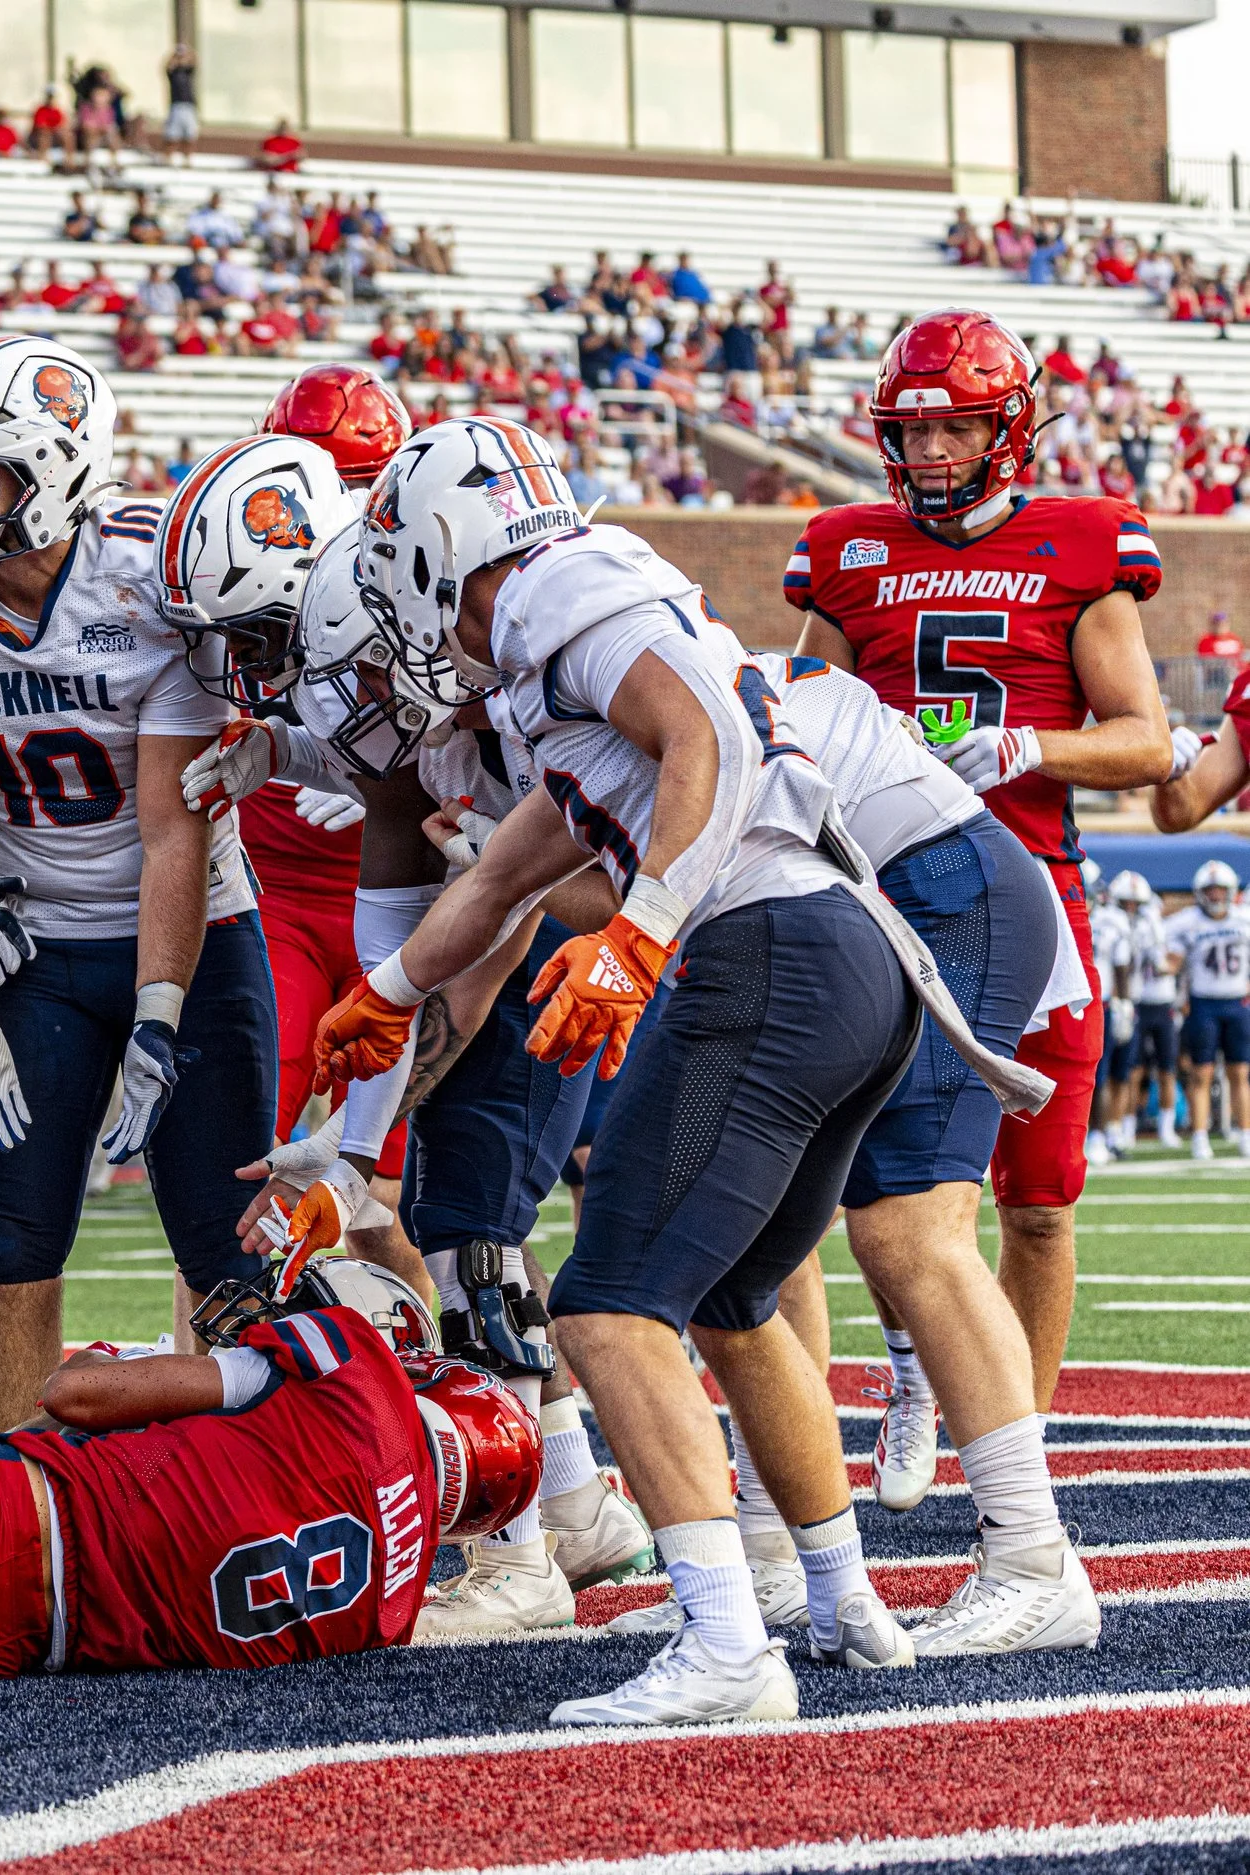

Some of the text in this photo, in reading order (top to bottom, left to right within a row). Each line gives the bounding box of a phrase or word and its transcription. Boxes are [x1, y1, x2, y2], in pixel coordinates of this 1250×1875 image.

[505, 508, 571, 545] THUNDER
[843, 550, 886, 561] PATRIOT
[843, 556, 886, 567] LEAGUE
[874, 570, 1047, 608] RICHMOND
[77, 635, 137, 647] PATRIOT
[77, 642, 138, 654] LEAGUE
[914, 610, 1010, 752] 5
[598, 944, 634, 993] adidas
[435, 1429, 463, 1525] RICHMOND
[376, 1473, 424, 1600] ALLEN
[210, 1512, 375, 1643] 8
